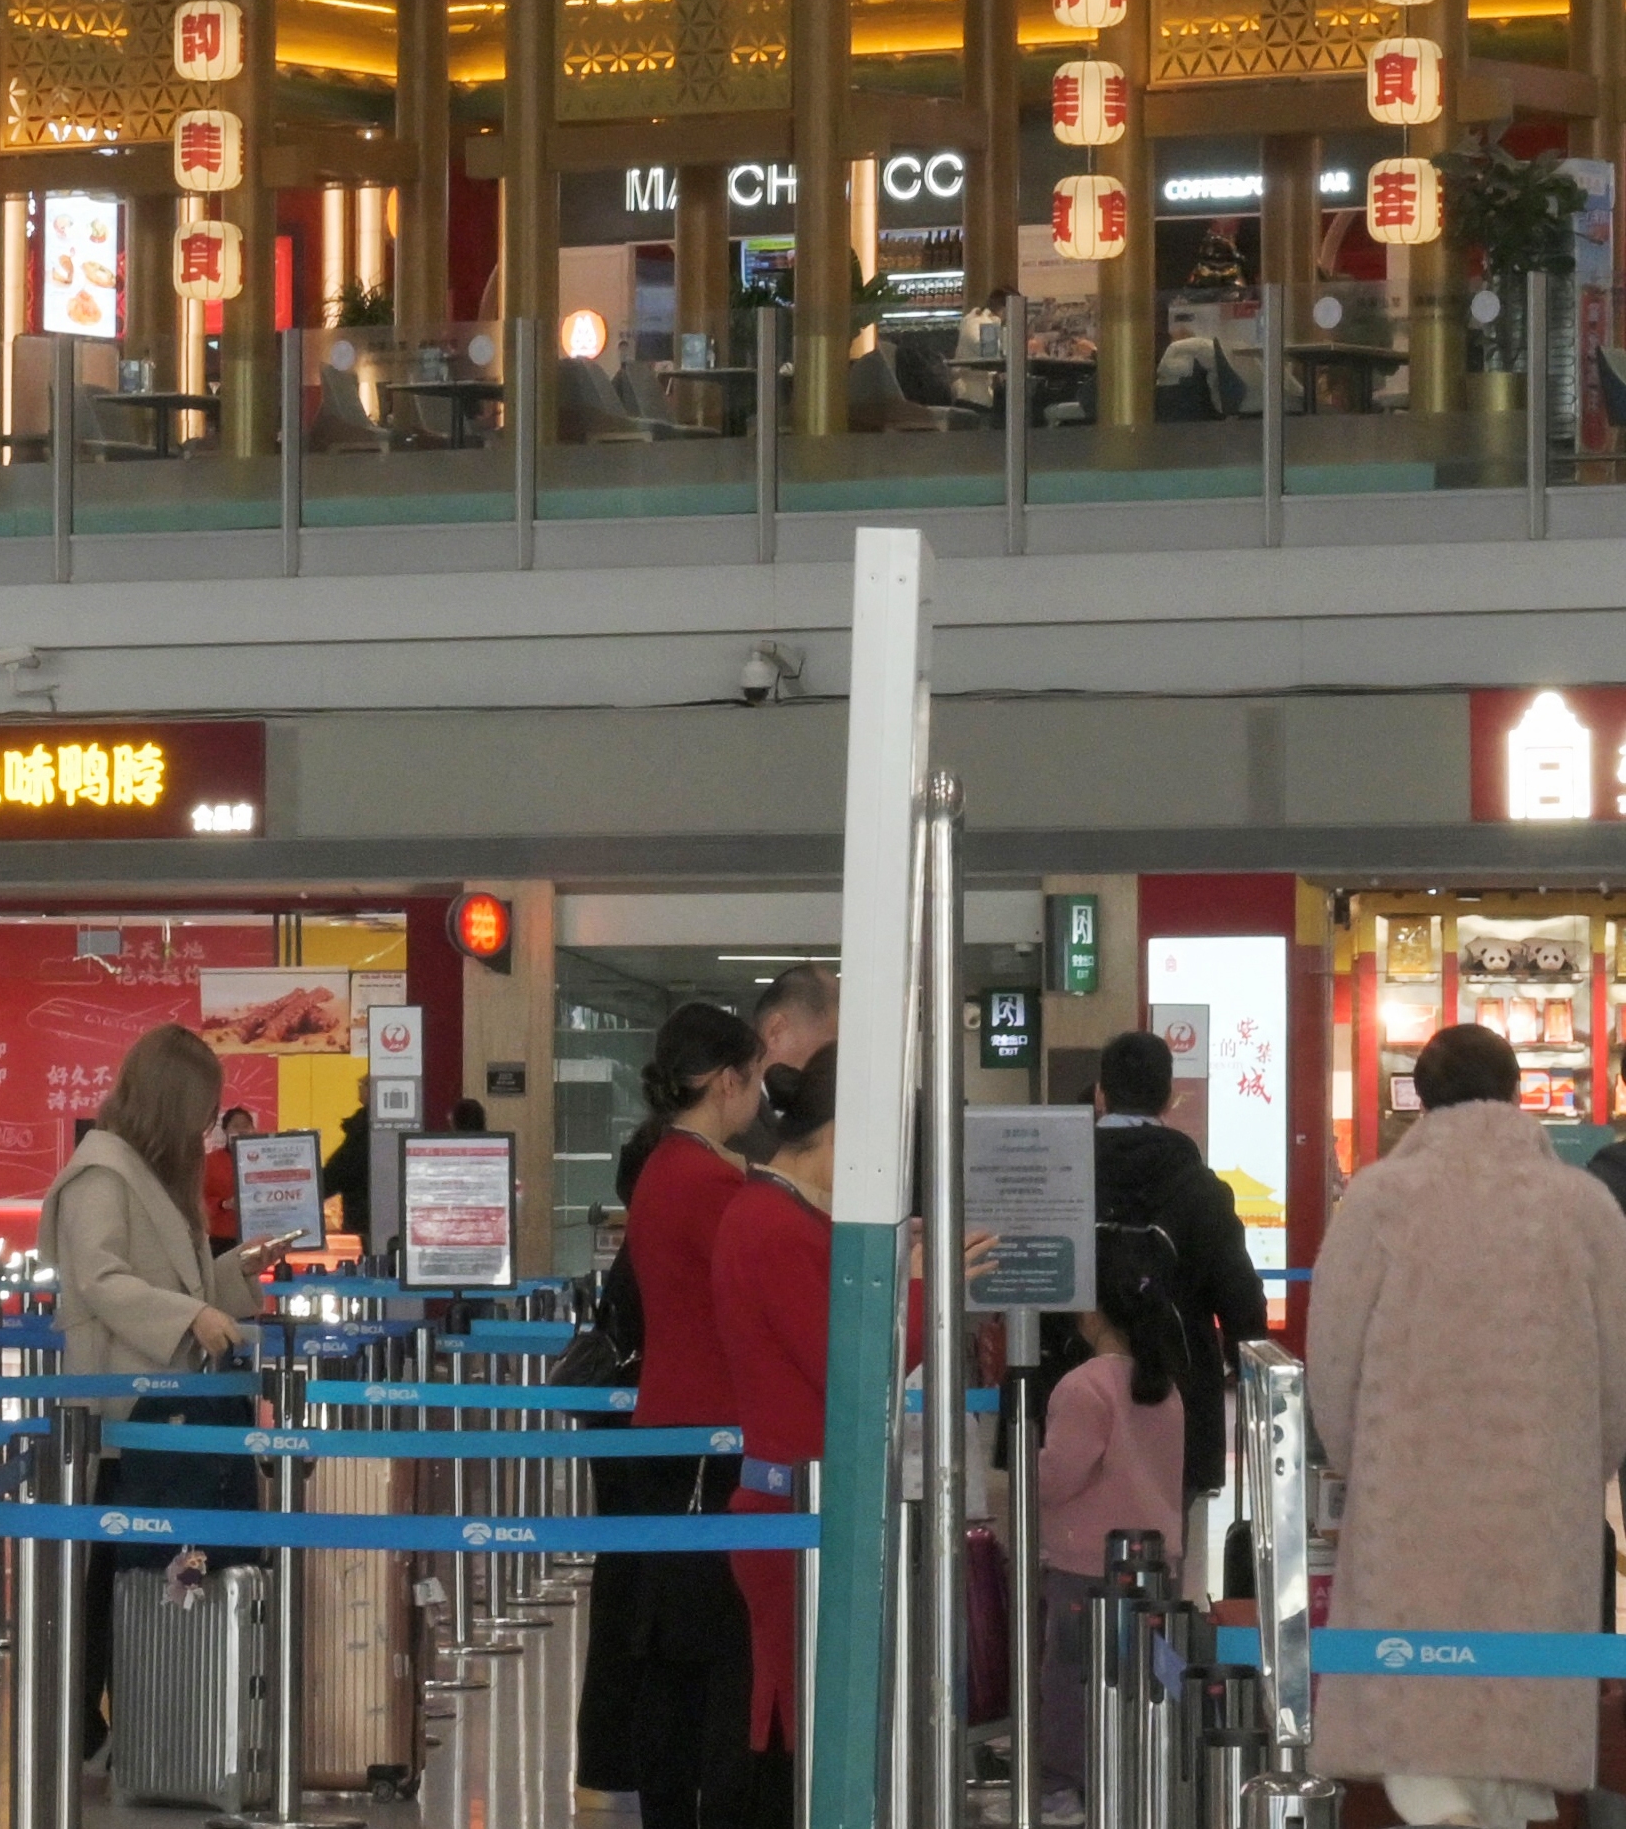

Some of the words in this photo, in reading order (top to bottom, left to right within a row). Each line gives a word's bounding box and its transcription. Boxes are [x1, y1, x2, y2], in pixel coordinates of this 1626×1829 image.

[151, 1380, 180, 1389] BCIA
[388, 1388, 420, 1400] BCIA
[273, 1435, 310, 1450] BCIA
[132, 1518, 173, 1532] BCIA
[495, 1527, 537, 1541] BCIA
[1420, 1645, 1477, 1663] BCIA
